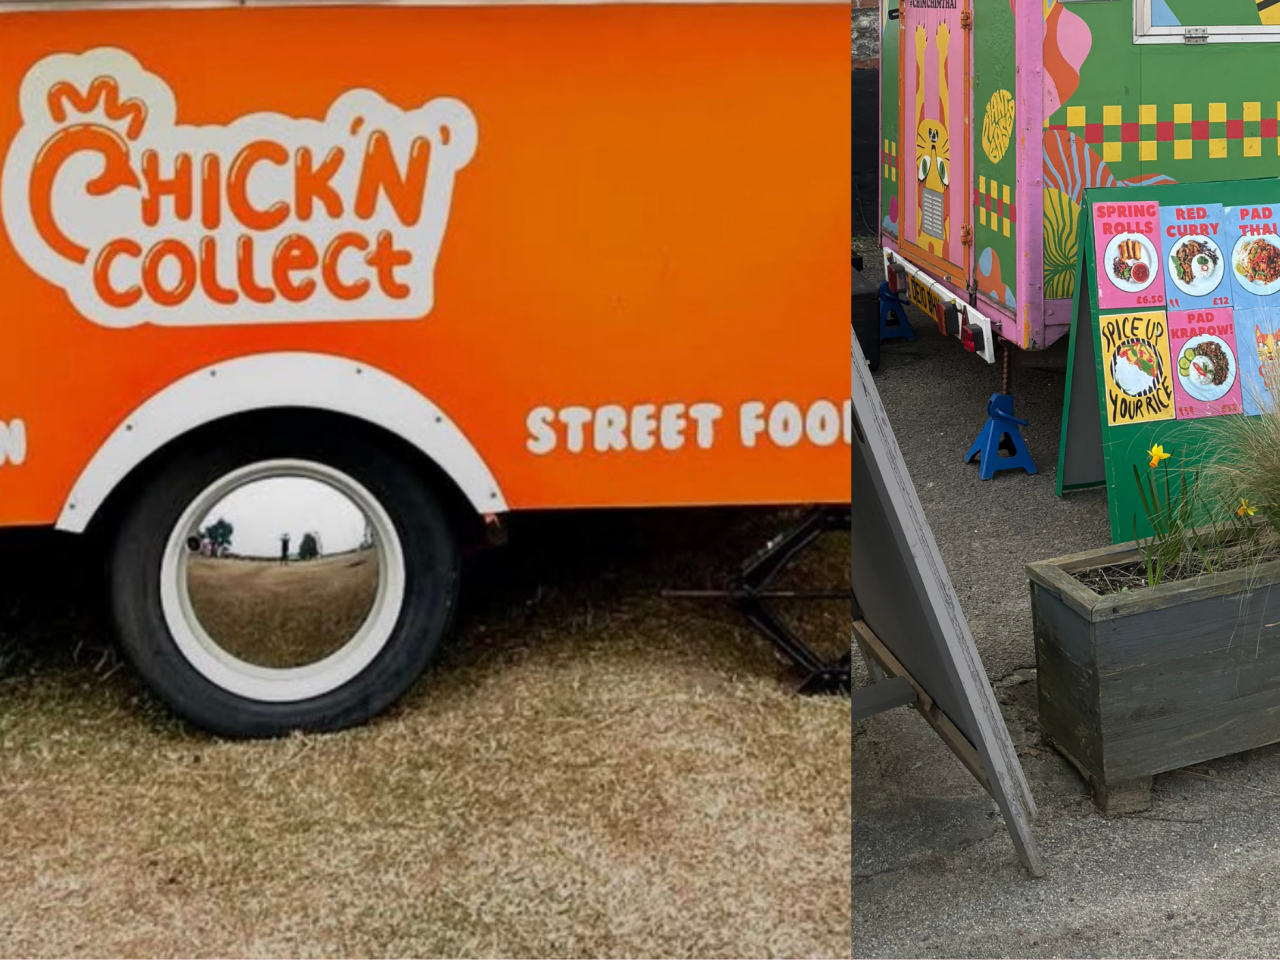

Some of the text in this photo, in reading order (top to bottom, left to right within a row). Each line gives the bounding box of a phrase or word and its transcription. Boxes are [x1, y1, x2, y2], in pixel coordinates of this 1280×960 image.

[1096, 204, 1157, 218] SPRING
[1175, 207, 1208, 221] RED
[1240, 207, 1273, 221] PAD
[1102, 221, 1154, 235] ROLLS
[1166, 222, 1219, 237] CURRY
[1239, 223, 1278, 236] THAI
[1136, 294, 1163, 304] £6.50
[1212, 296, 1229, 306] £12
[1187, 312, 1215, 324] PAD
[1102, 317, 1164, 353] SPICE UP
[1171, 324, 1234, 339] KRAPOW!
[1109, 376, 1173, 423] YOUR RICE
[526, 399, 851, 455] STREET FOO
